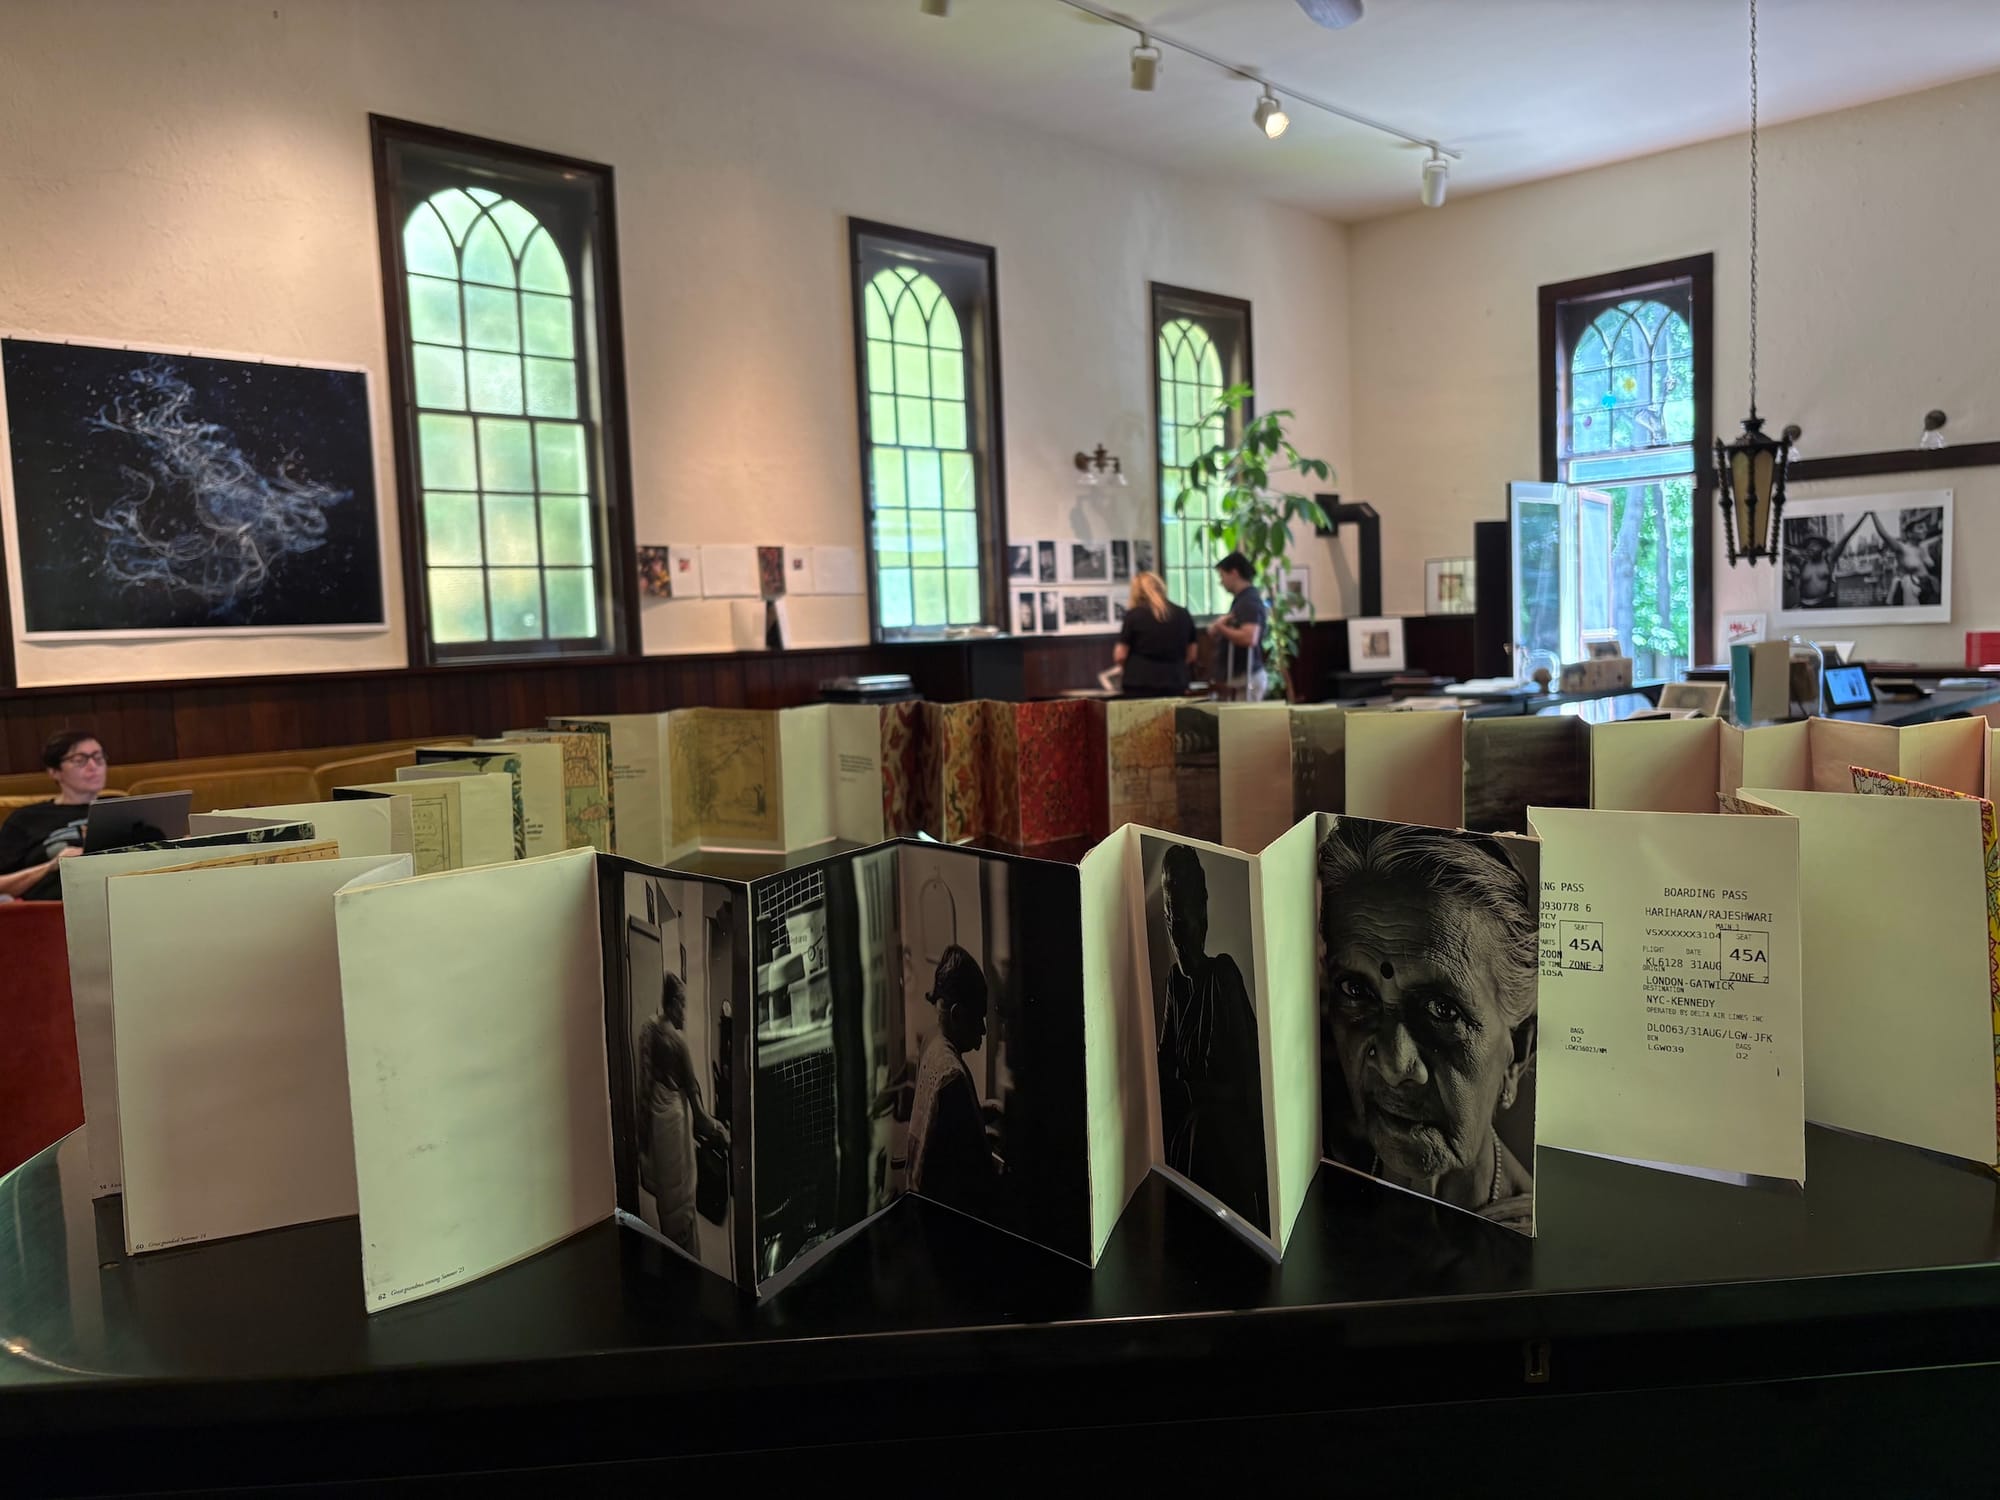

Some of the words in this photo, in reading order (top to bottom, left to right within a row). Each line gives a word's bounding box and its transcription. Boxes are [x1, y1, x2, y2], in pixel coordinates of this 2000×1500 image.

[1560, 882, 1585, 893] PASS
[1664, 887, 1716, 899] BOARDING
[1722, 889, 1748, 901] PASS
[1585, 903, 1592, 913] 6
[1645, 907, 1773, 922] HARIHARAN/RAJESHWARI
[1736, 933, 1752, 941] SEAT
[1569, 938, 1603, 952] 45A
[1642, 945, 1664, 953] FLIGHT
[1685, 948, 1702, 956] DATE
[1729, 948, 1767, 963] 45A
[1646, 957, 1683, 968] KL6128
[1690, 959, 1721, 971] 31AUG
[1729, 972, 1754, 983] ZONE
[1642, 984, 1685, 993] DESTINATION
[1646, 976, 1735, 991] LONDON-GATWICK
[1646, 995, 1715, 1008] NYC-KENNEDY
[1646, 1006, 1676, 1015] OPERATED
[1728, 1013, 1749, 1021] LINES
[1570, 1027, 1585, 1035] BAGS
[1647, 1023, 1773, 1043] DL0063/31AUG/LGW-JFK
[1570, 1036, 1582, 1044] 02
[1647, 1043, 1685, 1054] LGW039
[1735, 1043, 1752, 1051] BAGS
[1735, 1052, 1749, 1060] 02
[378, 1293, 387, 1301] 62
